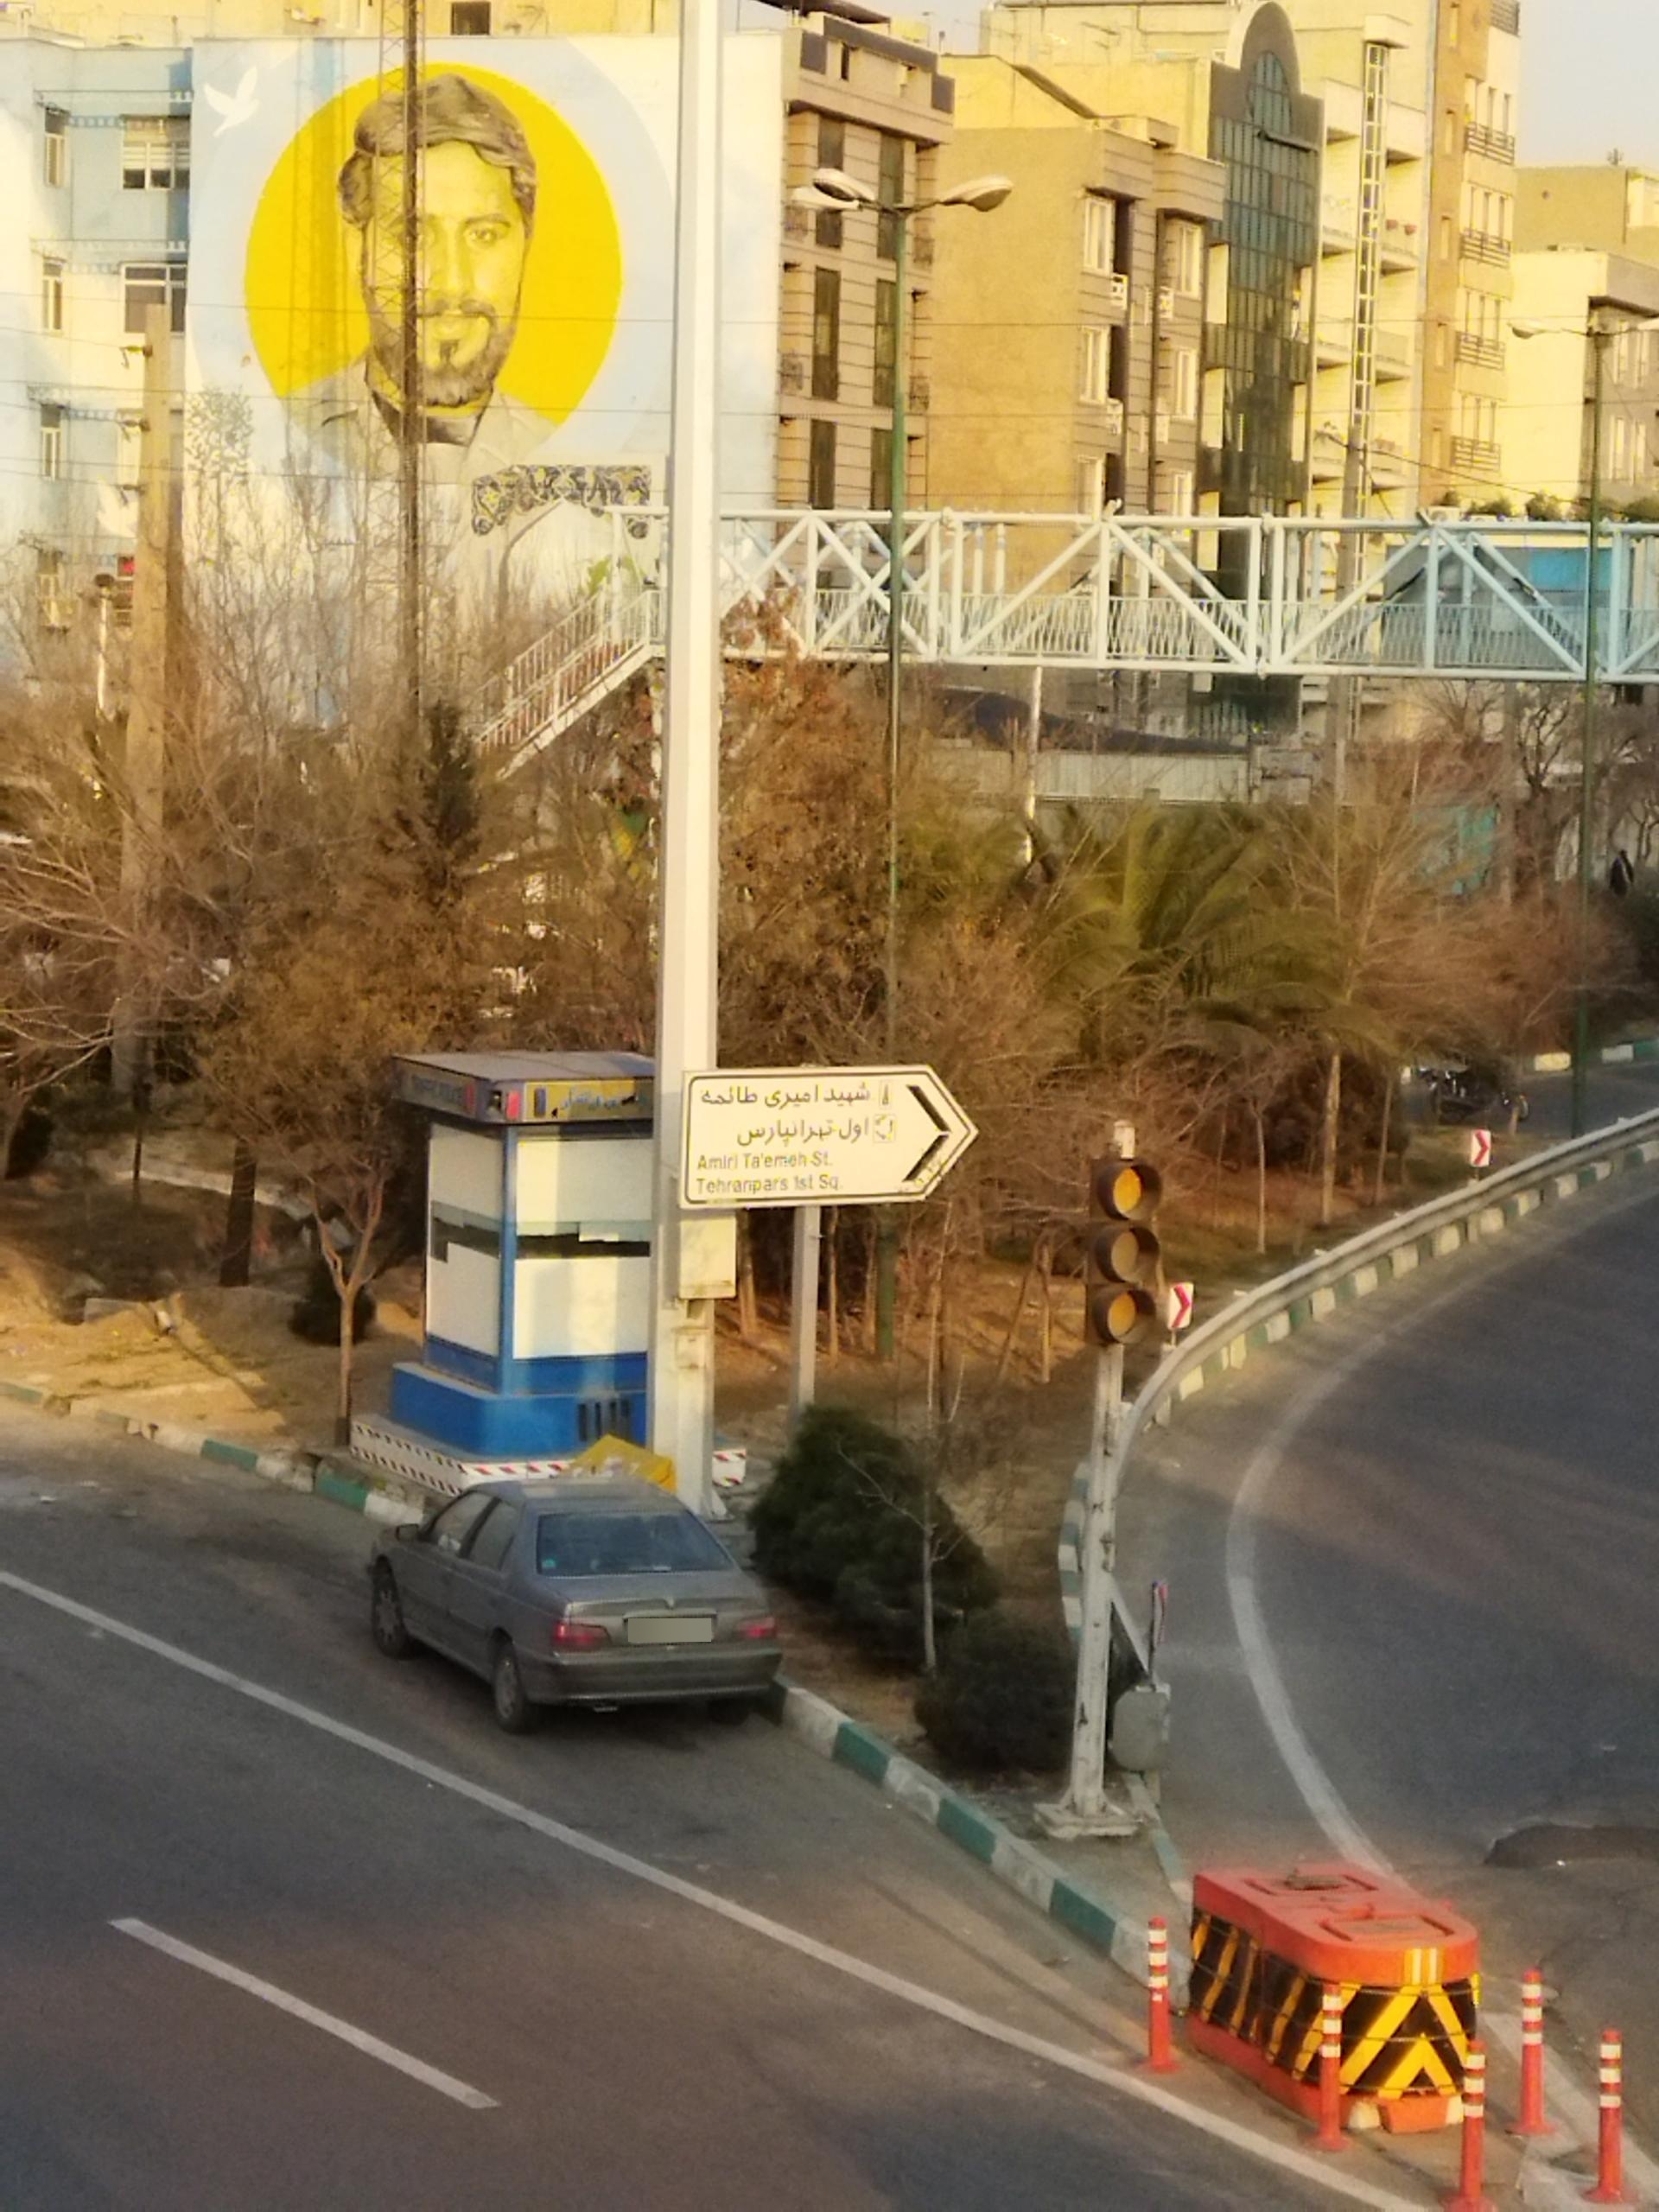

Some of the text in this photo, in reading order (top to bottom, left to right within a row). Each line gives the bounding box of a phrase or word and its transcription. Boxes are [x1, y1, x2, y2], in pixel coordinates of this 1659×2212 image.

[765, 1084, 818, 1109] امیری
[823, 1081, 870, 1106] شهید
[737, 1116, 868, 1147] اول تهرانپارس
[697, 1154, 738, 1170] Amiri
[743, 1152, 807, 1169] Ta'emeh
[696, 1176, 789, 1195] Tehranpars
[794, 1174, 812, 1189] 1st
